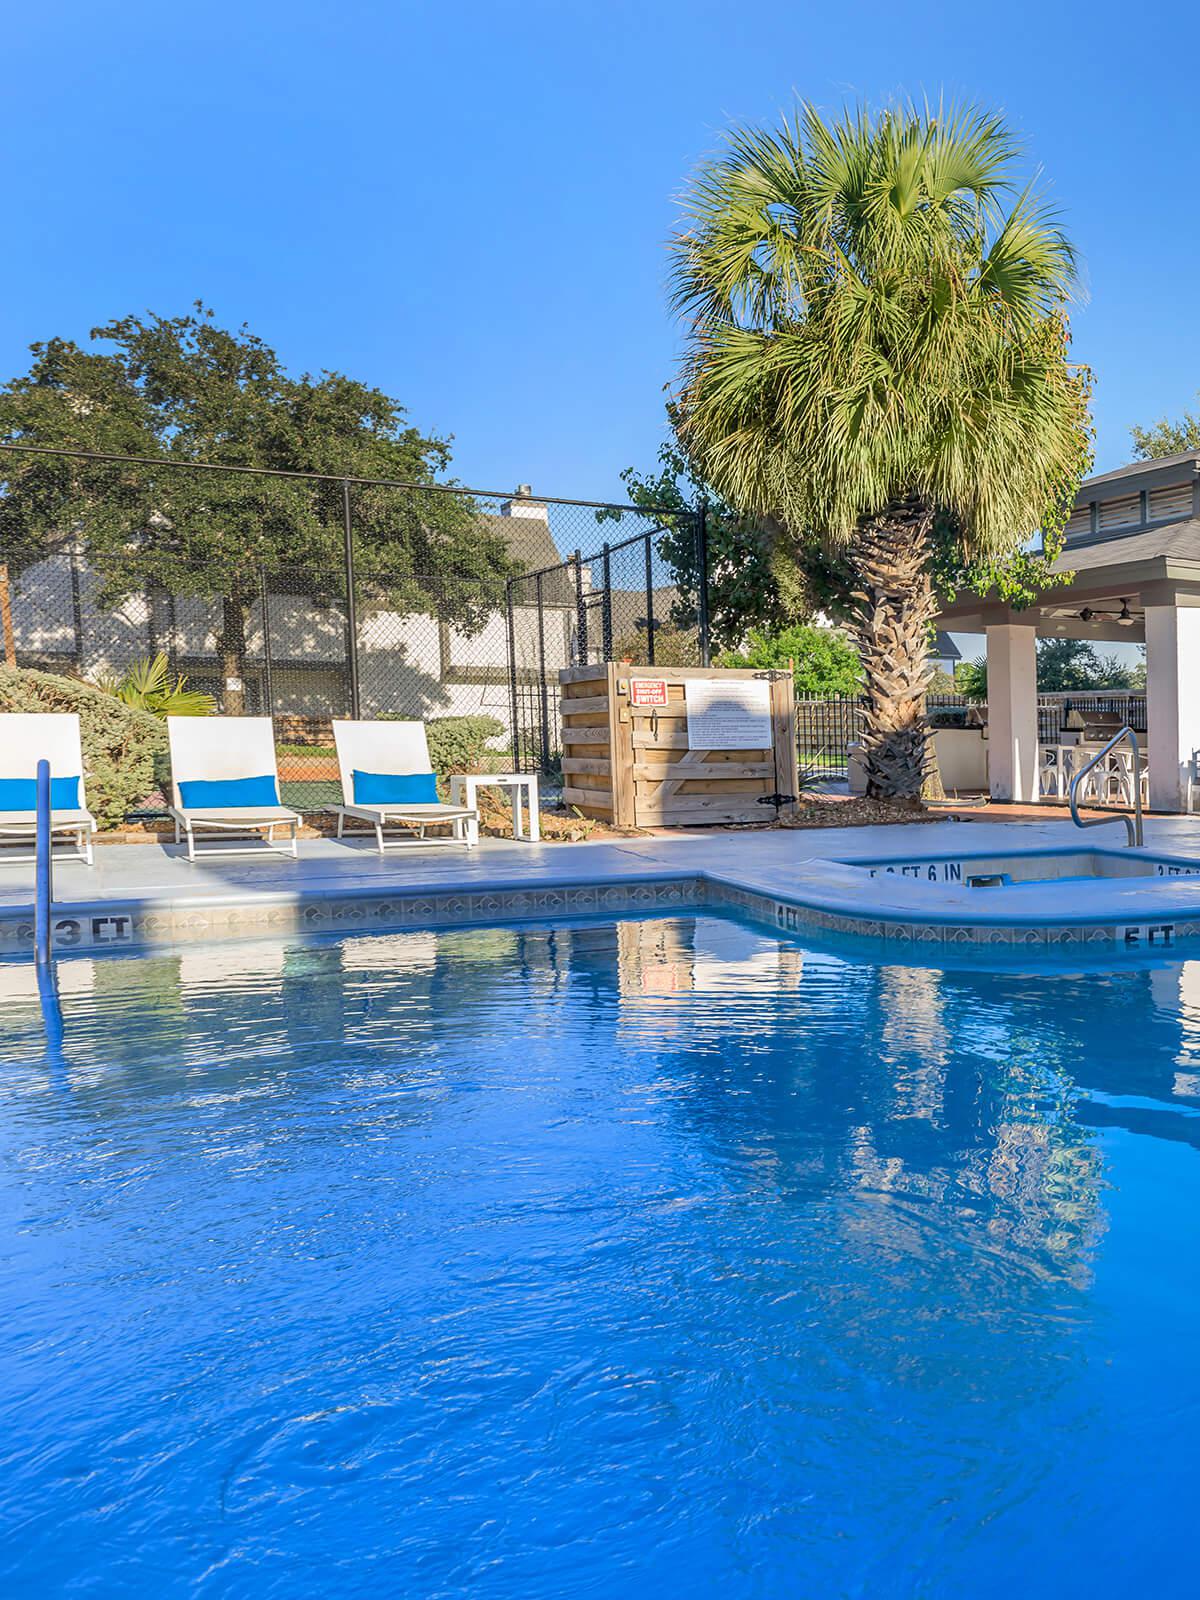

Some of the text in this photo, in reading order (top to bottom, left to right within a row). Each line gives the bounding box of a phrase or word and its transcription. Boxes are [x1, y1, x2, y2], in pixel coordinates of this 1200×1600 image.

[636, 695, 664, 703] SWITCH
[928, 864, 937, 881] 6
[944, 863, 961, 880] IN
[55, 919, 81, 943] 3
